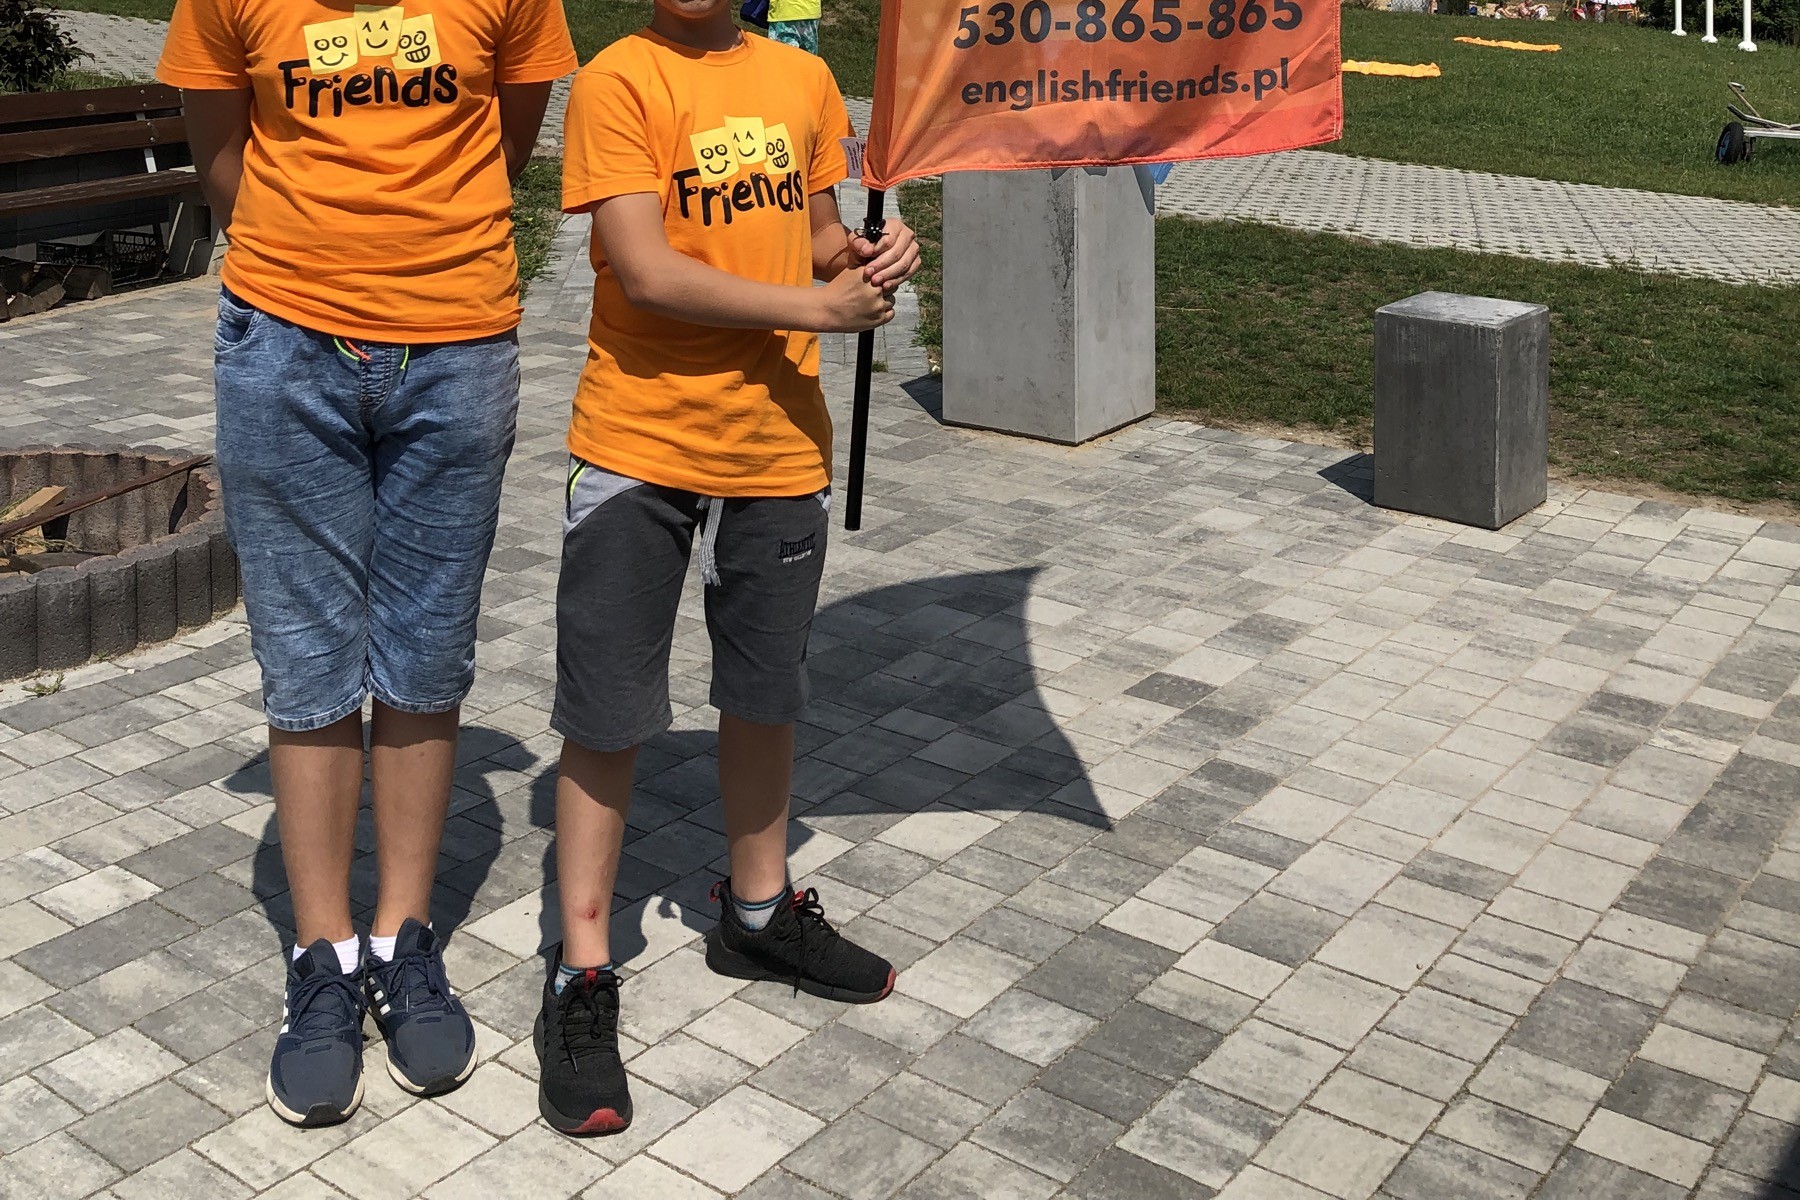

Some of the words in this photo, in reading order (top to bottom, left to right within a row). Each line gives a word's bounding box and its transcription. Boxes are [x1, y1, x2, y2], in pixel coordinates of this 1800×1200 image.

[278, 58, 458, 118] Friends
[961, 57, 1289, 112] englishfriends.pl
[672, 166, 804, 227] Friends
